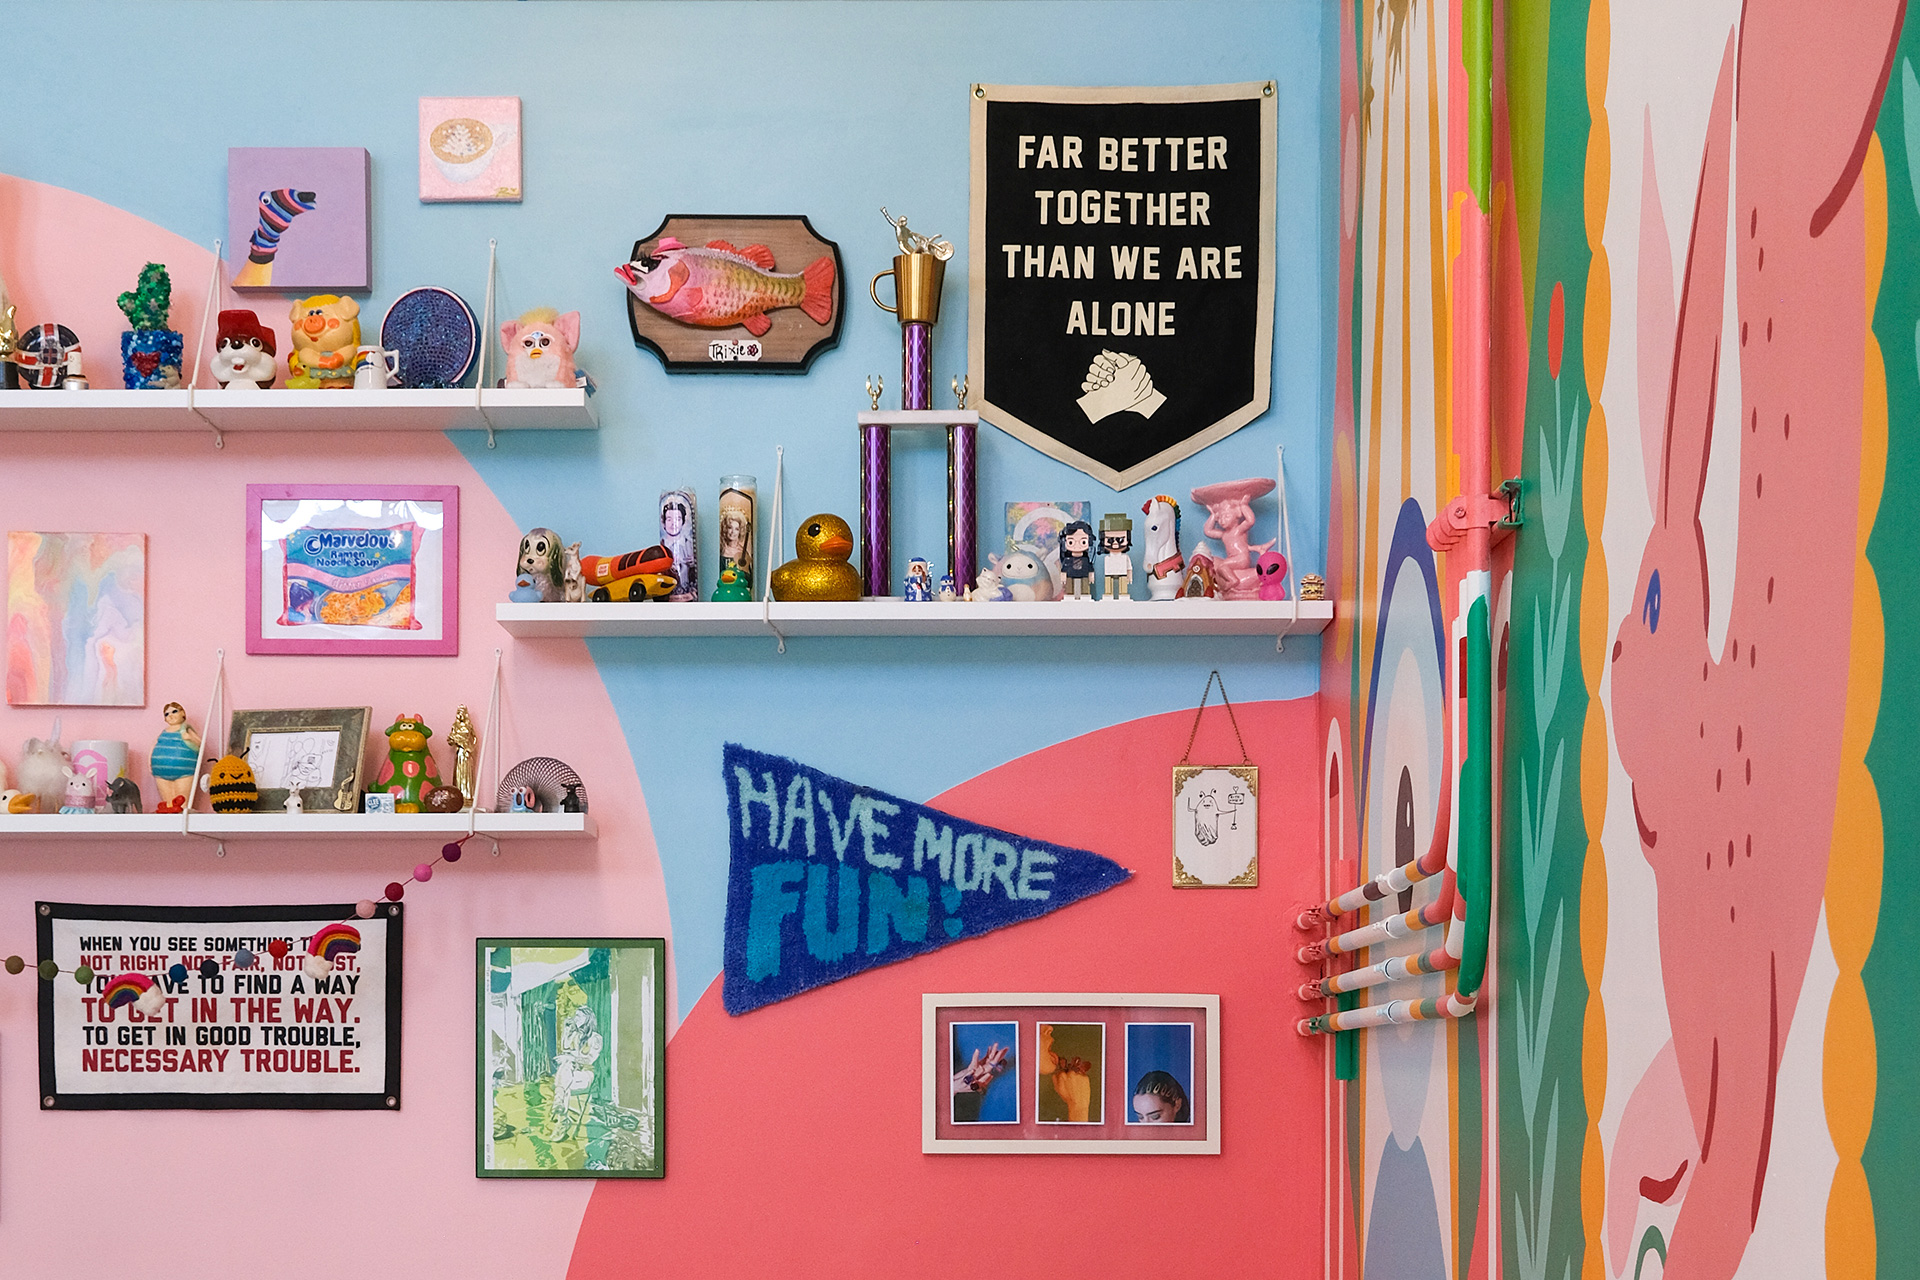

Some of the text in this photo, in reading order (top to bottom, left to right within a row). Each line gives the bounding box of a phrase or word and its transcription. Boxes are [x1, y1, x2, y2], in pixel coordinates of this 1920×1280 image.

[1018, 135, 1228, 172] FAR BETTER
[1034, 190, 1211, 226] TOGETHER
[1002, 244, 1242, 280] THAN WE ARE
[1066, 301, 1176, 336] ALONE
[316, 557, 380, 568] Noodle Soup
[330, 550, 366, 560] Ramen
[734, 765, 1059, 901] HAVE MORE
[745, 859, 964, 983] FUN!
[79, 936, 122, 952] WHEN
[129, 936, 161, 952] YOU
[168, 937, 198, 952] SEE
[272, 955, 305, 971] NOT
[197, 974, 224, 994] TO
[234, 974, 281, 994] FIND
[290, 974, 305, 994] A
[315, 975, 360, 994] WAY
[81, 997, 116, 1023] TO
[191, 997, 217, 1023] IN
[230, 997, 282, 1023] THE
[294, 997, 361, 1023] WAY.
[82, 1026, 361, 1049] TO GET IN GOOD TROUBLE,
[82, 1049, 361, 1073] NECESSARY TROUBLE.
